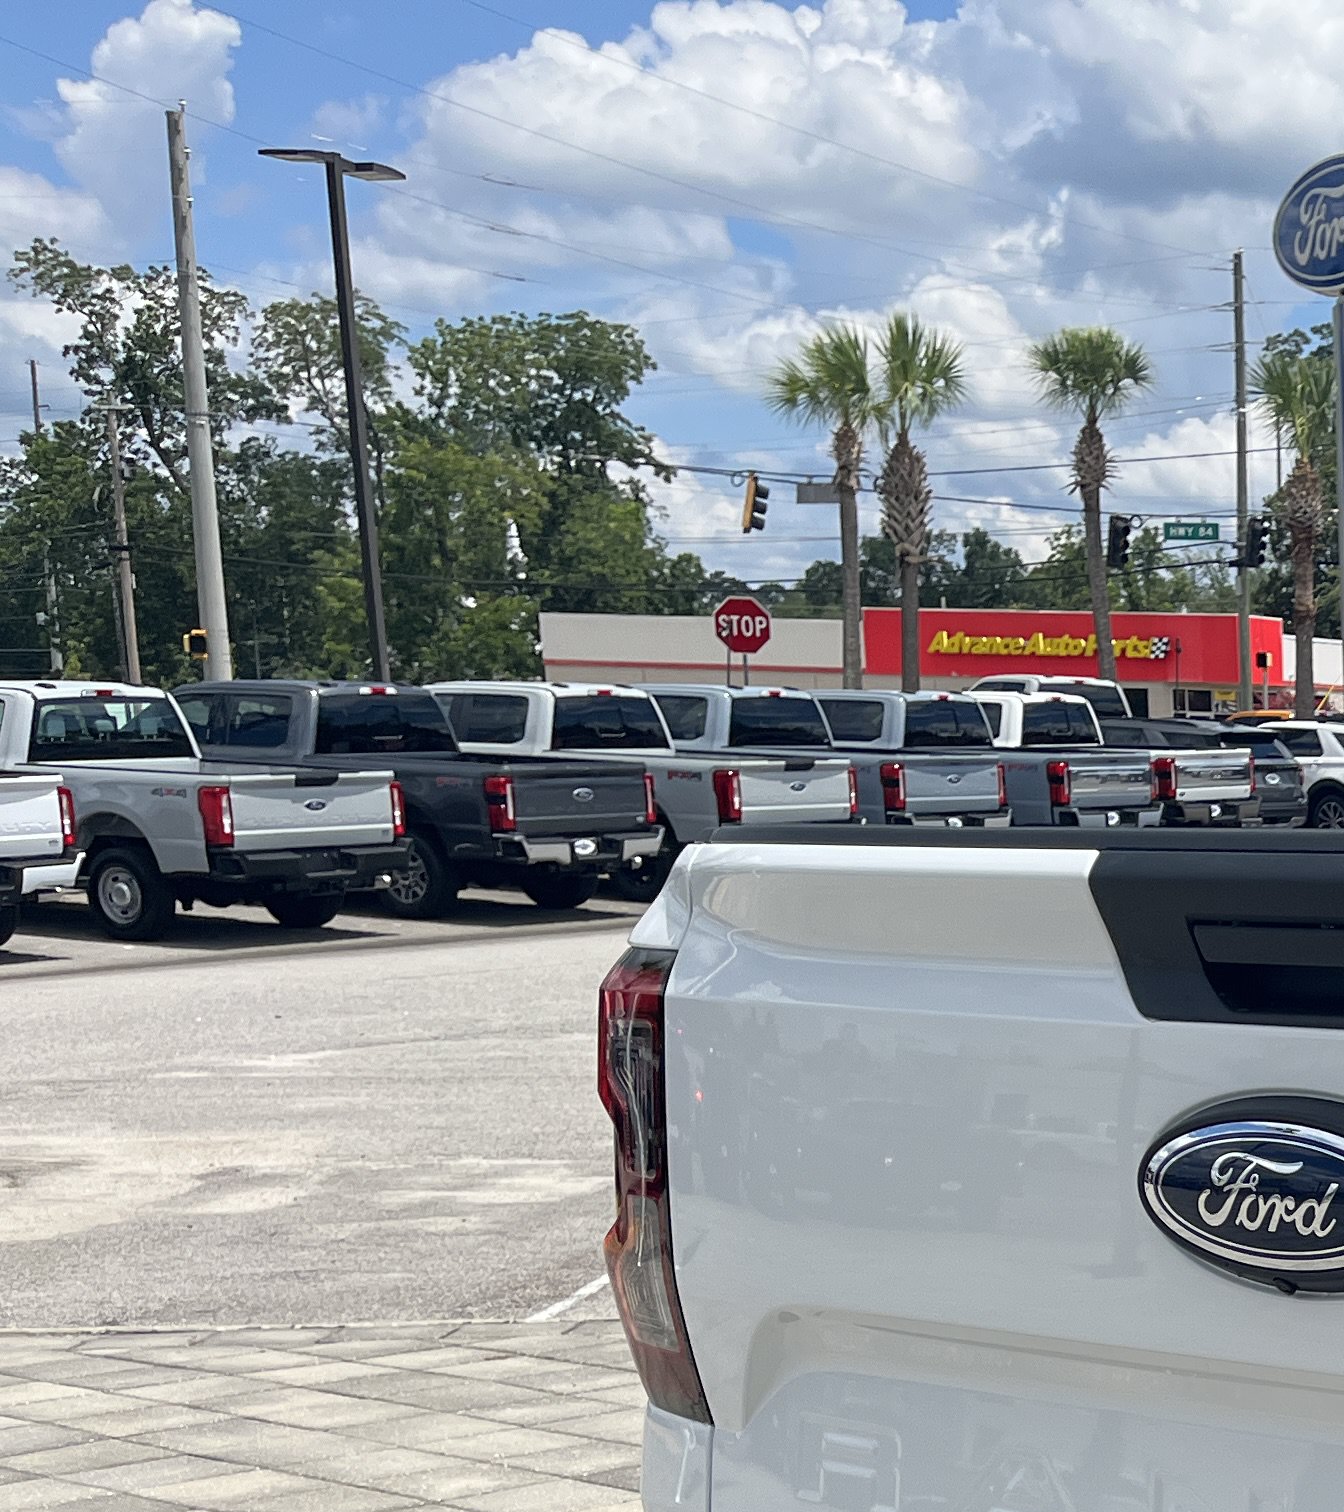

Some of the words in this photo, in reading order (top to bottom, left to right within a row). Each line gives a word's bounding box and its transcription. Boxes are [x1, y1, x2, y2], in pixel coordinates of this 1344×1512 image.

[1169, 526, 1194, 537] HWY
[1198, 526, 1213, 537] 84
[718, 614, 768, 638] STOP
[1198, 1151, 1339, 1237] Ford
